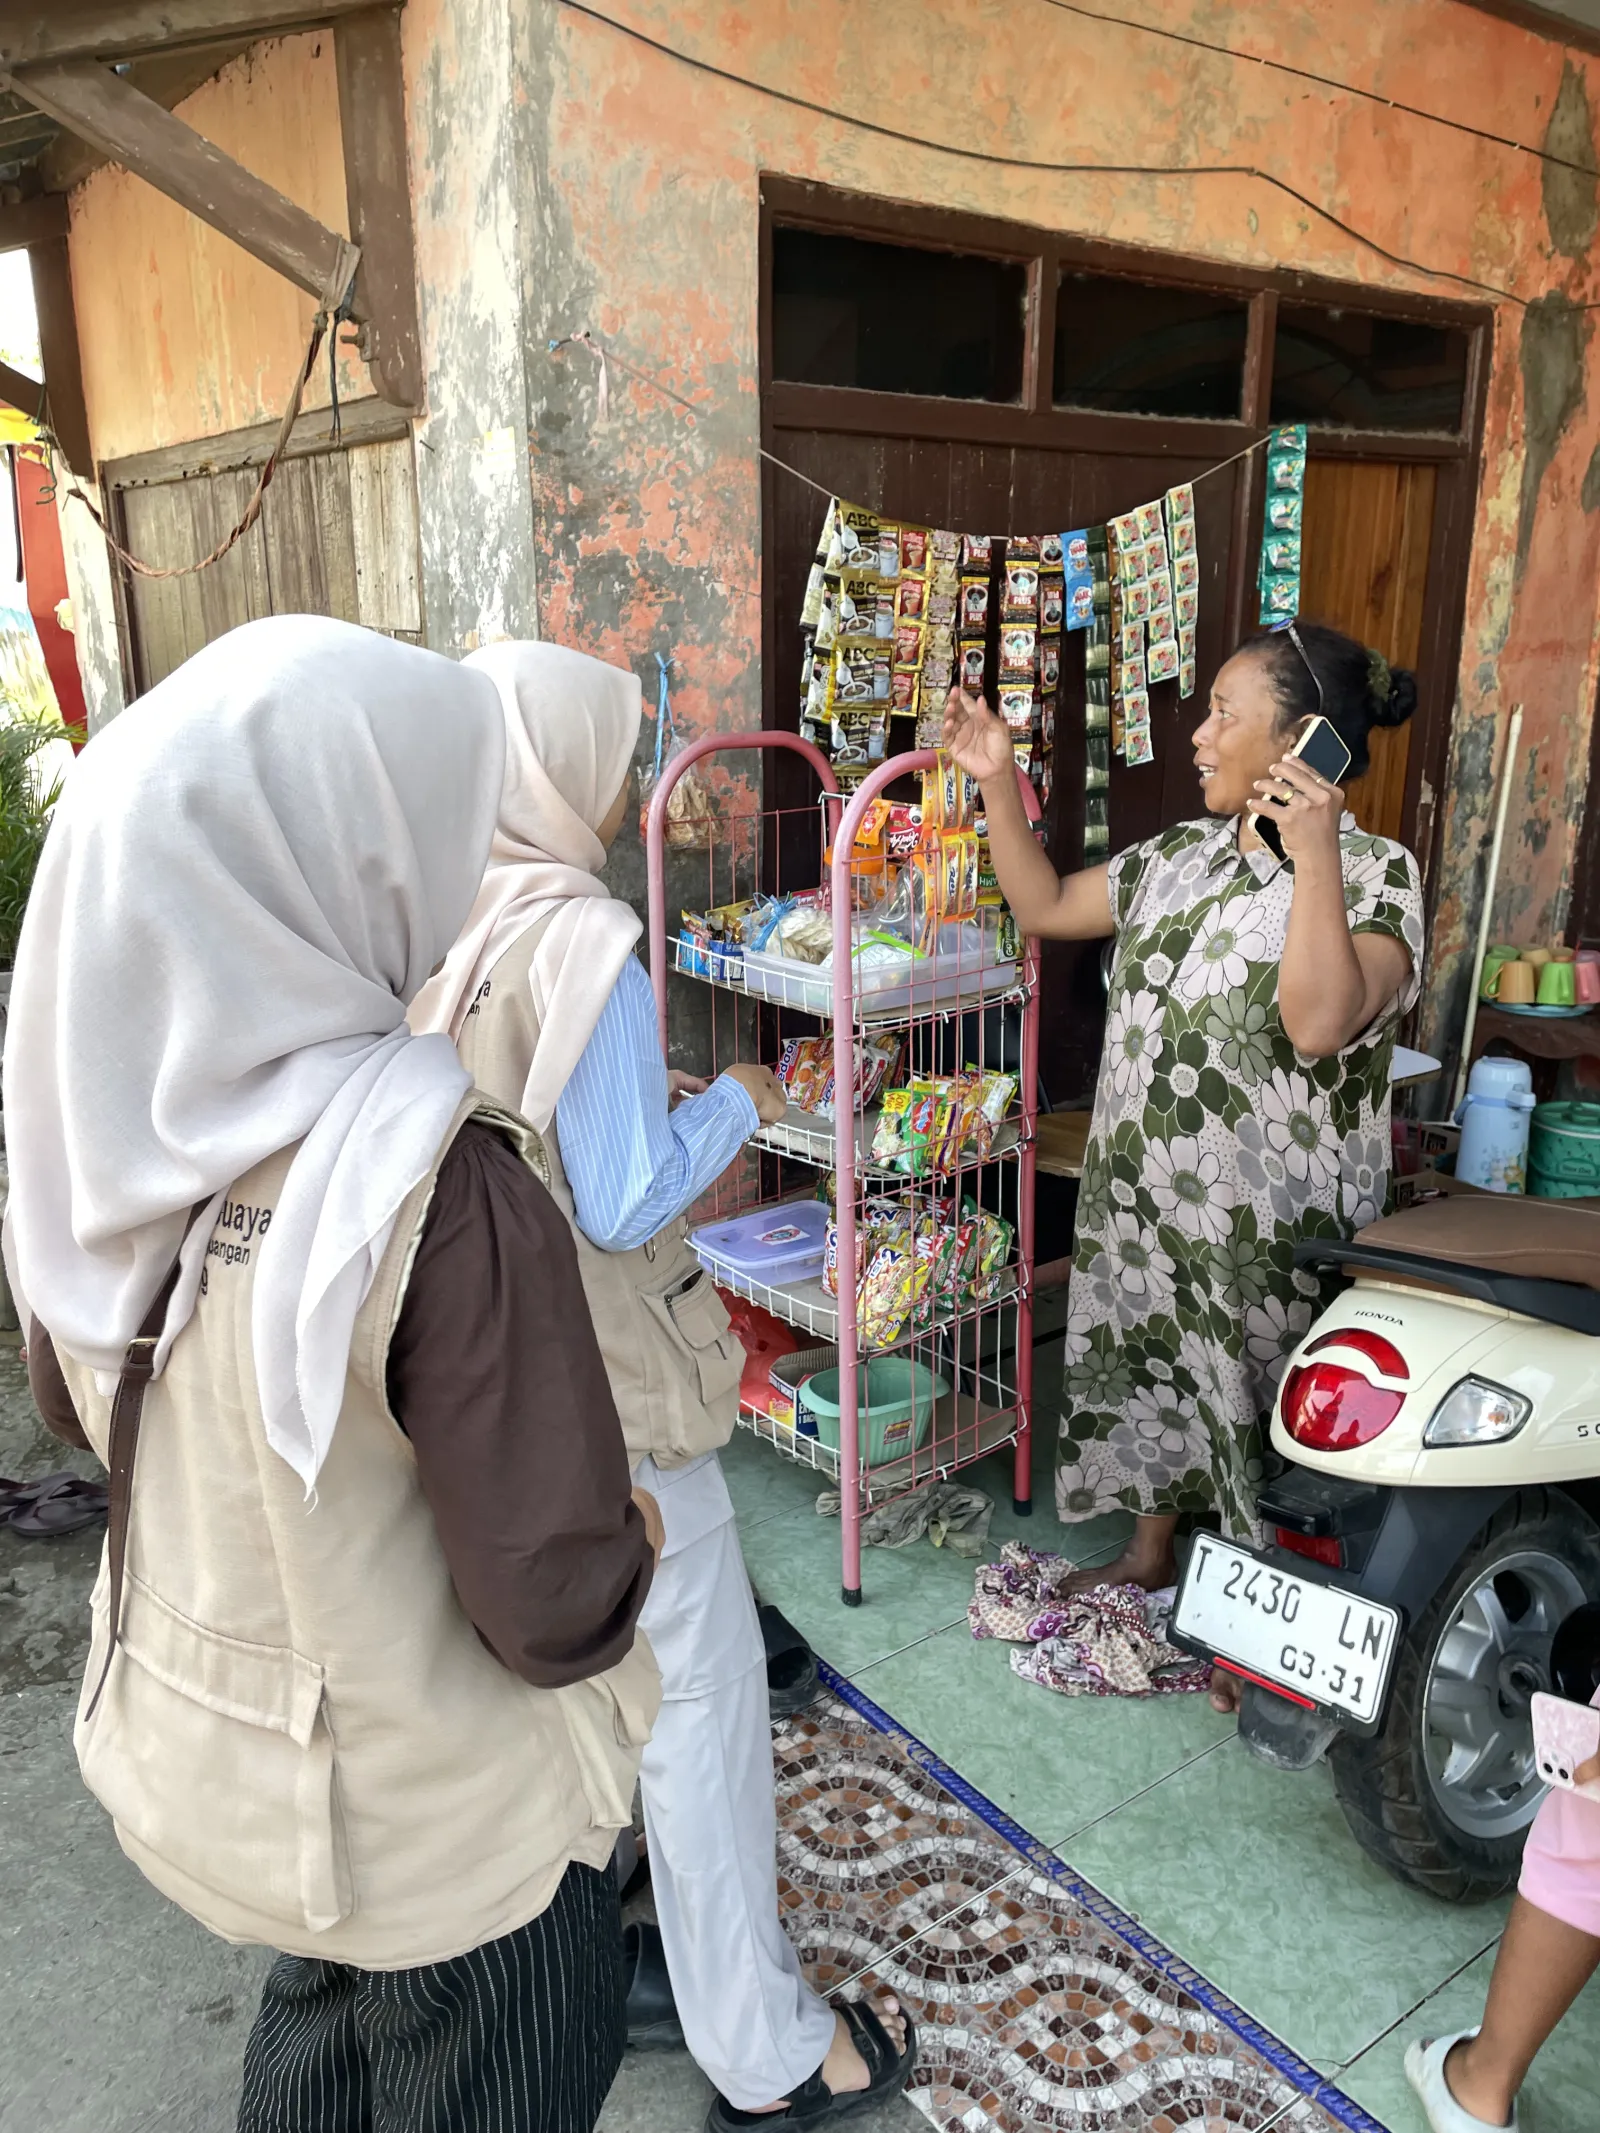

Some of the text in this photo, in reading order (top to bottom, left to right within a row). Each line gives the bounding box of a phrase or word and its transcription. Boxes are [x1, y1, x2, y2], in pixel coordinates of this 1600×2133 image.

[846, 512, 878, 529] ABC
[973, 548, 988, 558] PLUS
[846, 580, 877, 596] ABC
[1013, 596, 1031, 605] PLUS
[969, 612, 983, 621] PLUS
[843, 647, 875, 662] ABC
[1009, 657, 1028, 667] PLUS
[967, 675, 981, 684] PLUS
[839, 712, 869, 726] ABC
[1007, 718, 1026, 727] PLUS
[217, 1200, 272, 1242] uaya
[208, 1237, 250, 1265] uangan
[869, 1261, 882, 1277] ISI
[882, 1248, 902, 1265] 2
[1354, 1309, 1404, 1327] HONDA
[1196, 1545, 1385, 1661] T 2430 LN
